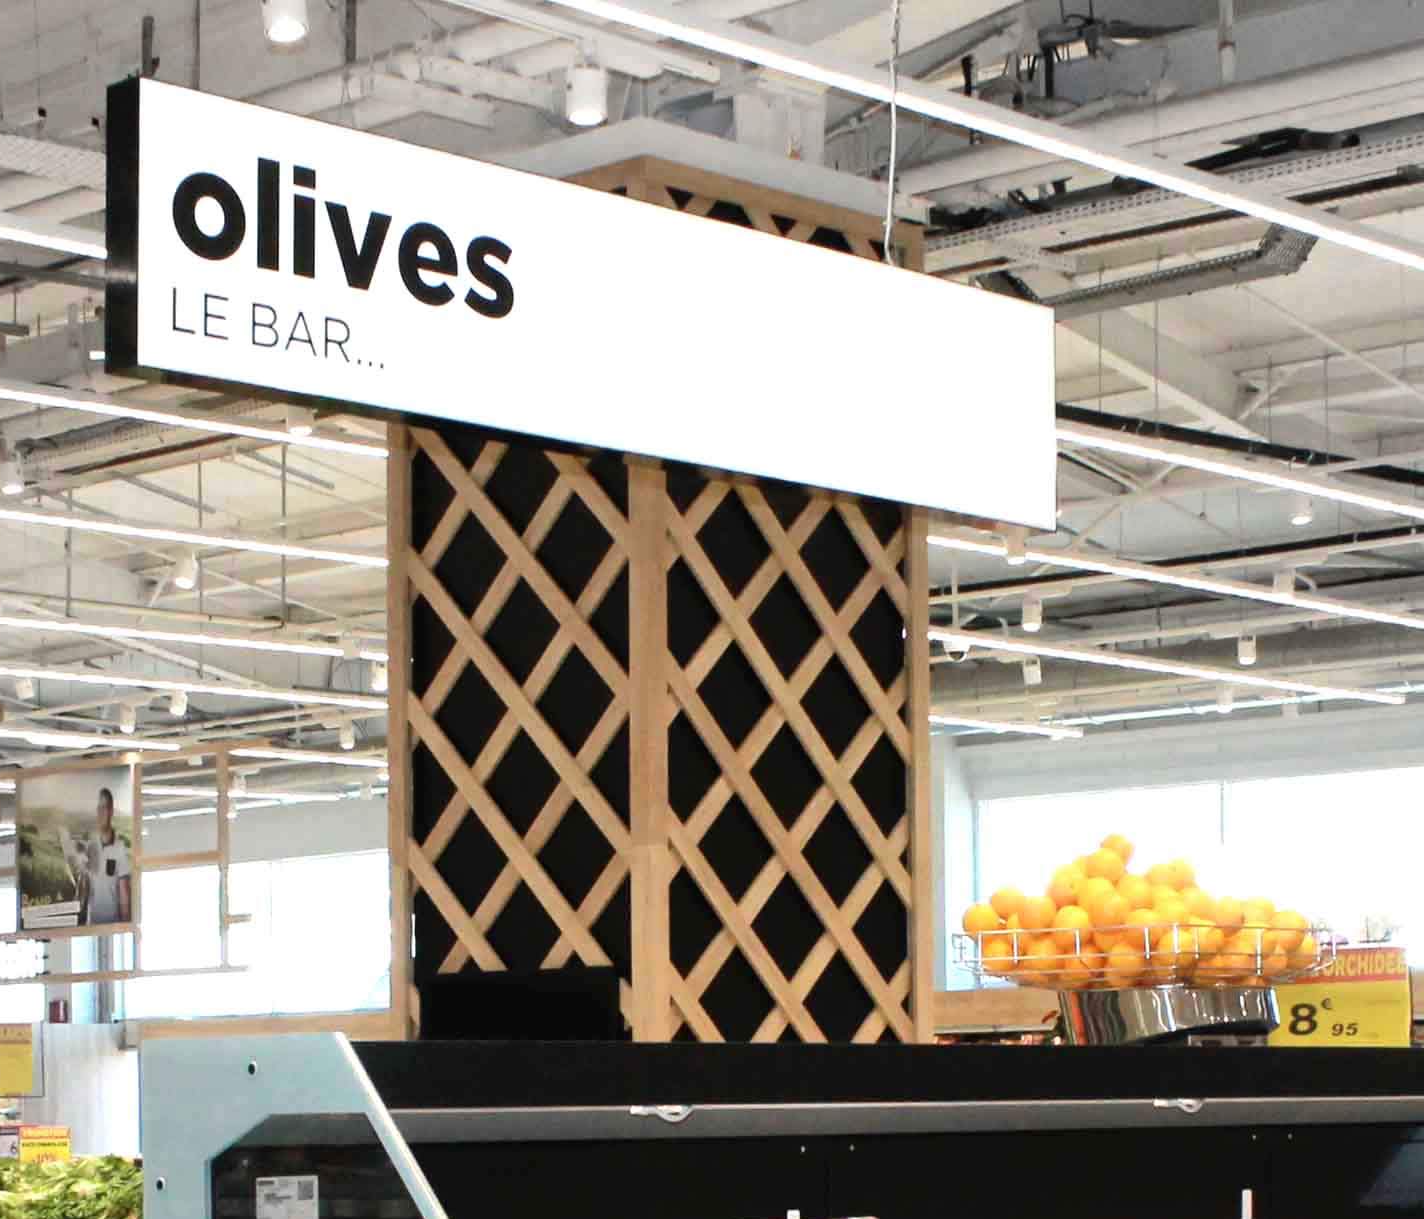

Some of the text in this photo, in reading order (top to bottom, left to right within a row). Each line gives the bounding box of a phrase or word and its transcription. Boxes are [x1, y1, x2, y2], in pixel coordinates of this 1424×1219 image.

[172, 156, 514, 319] olives
[172, 287, 385, 370] LE BAR...
[1288, 1003, 1318, 1036] 8
[1331, 1023, 1360, 1037] 95
